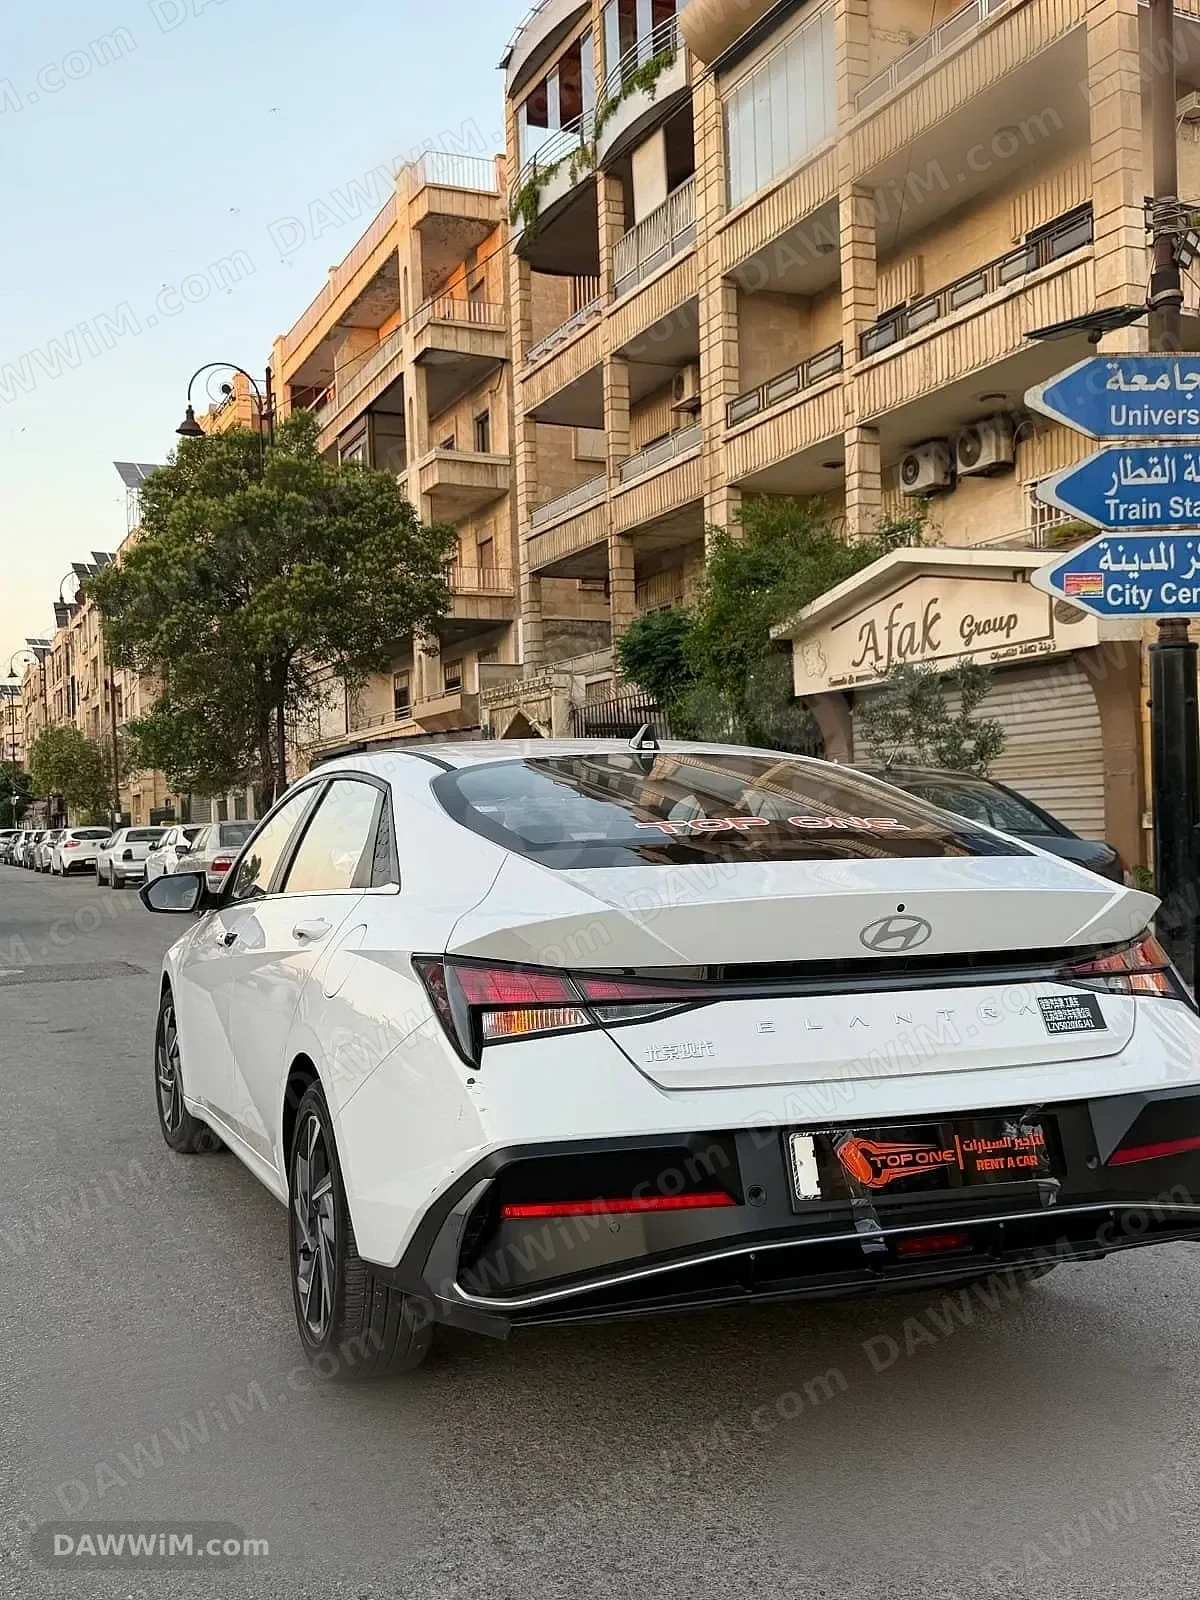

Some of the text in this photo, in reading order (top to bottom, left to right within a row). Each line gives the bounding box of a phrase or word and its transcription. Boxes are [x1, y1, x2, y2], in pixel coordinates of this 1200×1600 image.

[1110, 404, 1200, 427] Univers
[1104, 454, 1176, 497] القطار
[1104, 497, 1161, 521] Train
[1098, 541, 1176, 580] المدينة
[1106, 583, 1152, 611] City
[851, 597, 1018, 674] Afak Group
[634, 816, 912, 834] TOP ONE
[753, 1004, 1037, 1034] ELANTRA
[962, 1136, 1012, 1154] السيارات
[870, 1148, 956, 1169] TOP ONE
[976, 1155, 1039, 1171] RENT A CAR
